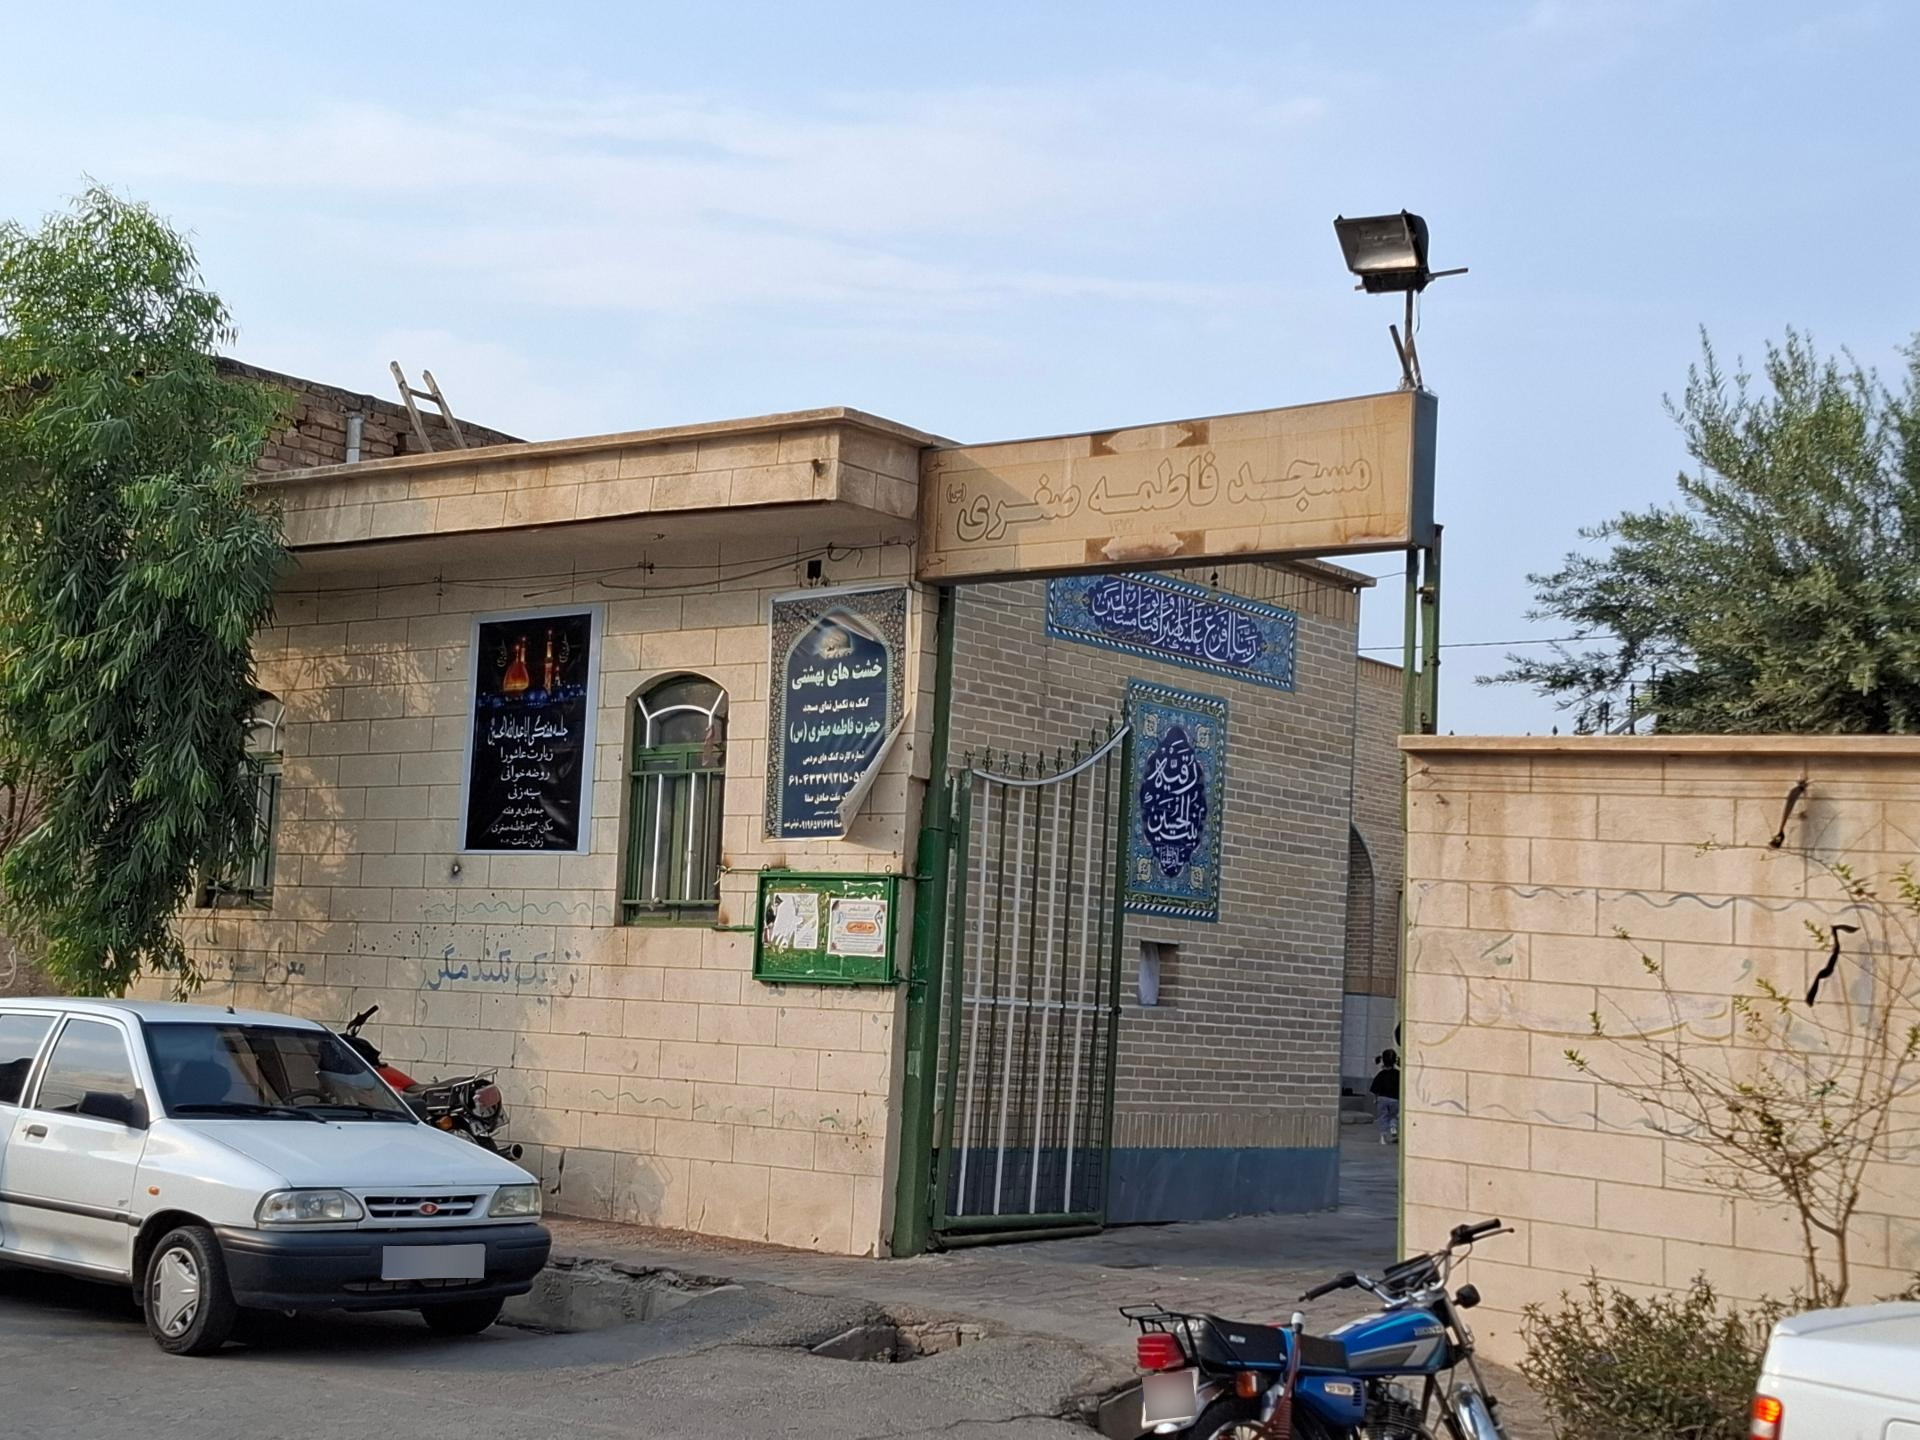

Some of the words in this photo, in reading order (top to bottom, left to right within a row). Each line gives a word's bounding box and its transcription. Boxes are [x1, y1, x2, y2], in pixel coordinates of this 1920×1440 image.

[1088, 451, 1219, 515] فاطمه
[1227, 456, 1373, 512] مسجد
[957, 473, 1081, 542] صغری
[792, 665, 824, 690] بهشتی
[827, 661, 849, 687] های
[852, 658, 883, 679] خشت
[802, 704, 818, 714] مسجد
[818, 700, 832, 713] نمای
[832, 699, 848, 713] تکمیل
[849, 701, 855, 711] به
[855, 697, 870, 708] کمک
[528, 715, 553, 746] هفتگی
[553, 714, 568, 742] جلسه
[790, 720, 807, 743] (س)
[808, 720, 831, 742] صغری
[832, 716, 855, 735] فاطمه
[855, 716, 881, 739] حضرت
[500, 745, 527, 763] عاشورا
[527, 744, 554, 762] زیارت
[802, 755, 818, 765] مردمی
[818, 753, 828, 764] های
[828, 752, 839, 761] کمک
[839, 751, 852, 763] کارت
[500, 765, 526, 782] خوانی
[526, 768, 551, 781] روضه
[508, 784, 524, 799] زنی
[524, 787, 542, 799] سینه
[524, 821, 538, 835] مسجد
[427, 942, 470, 991] مگر
